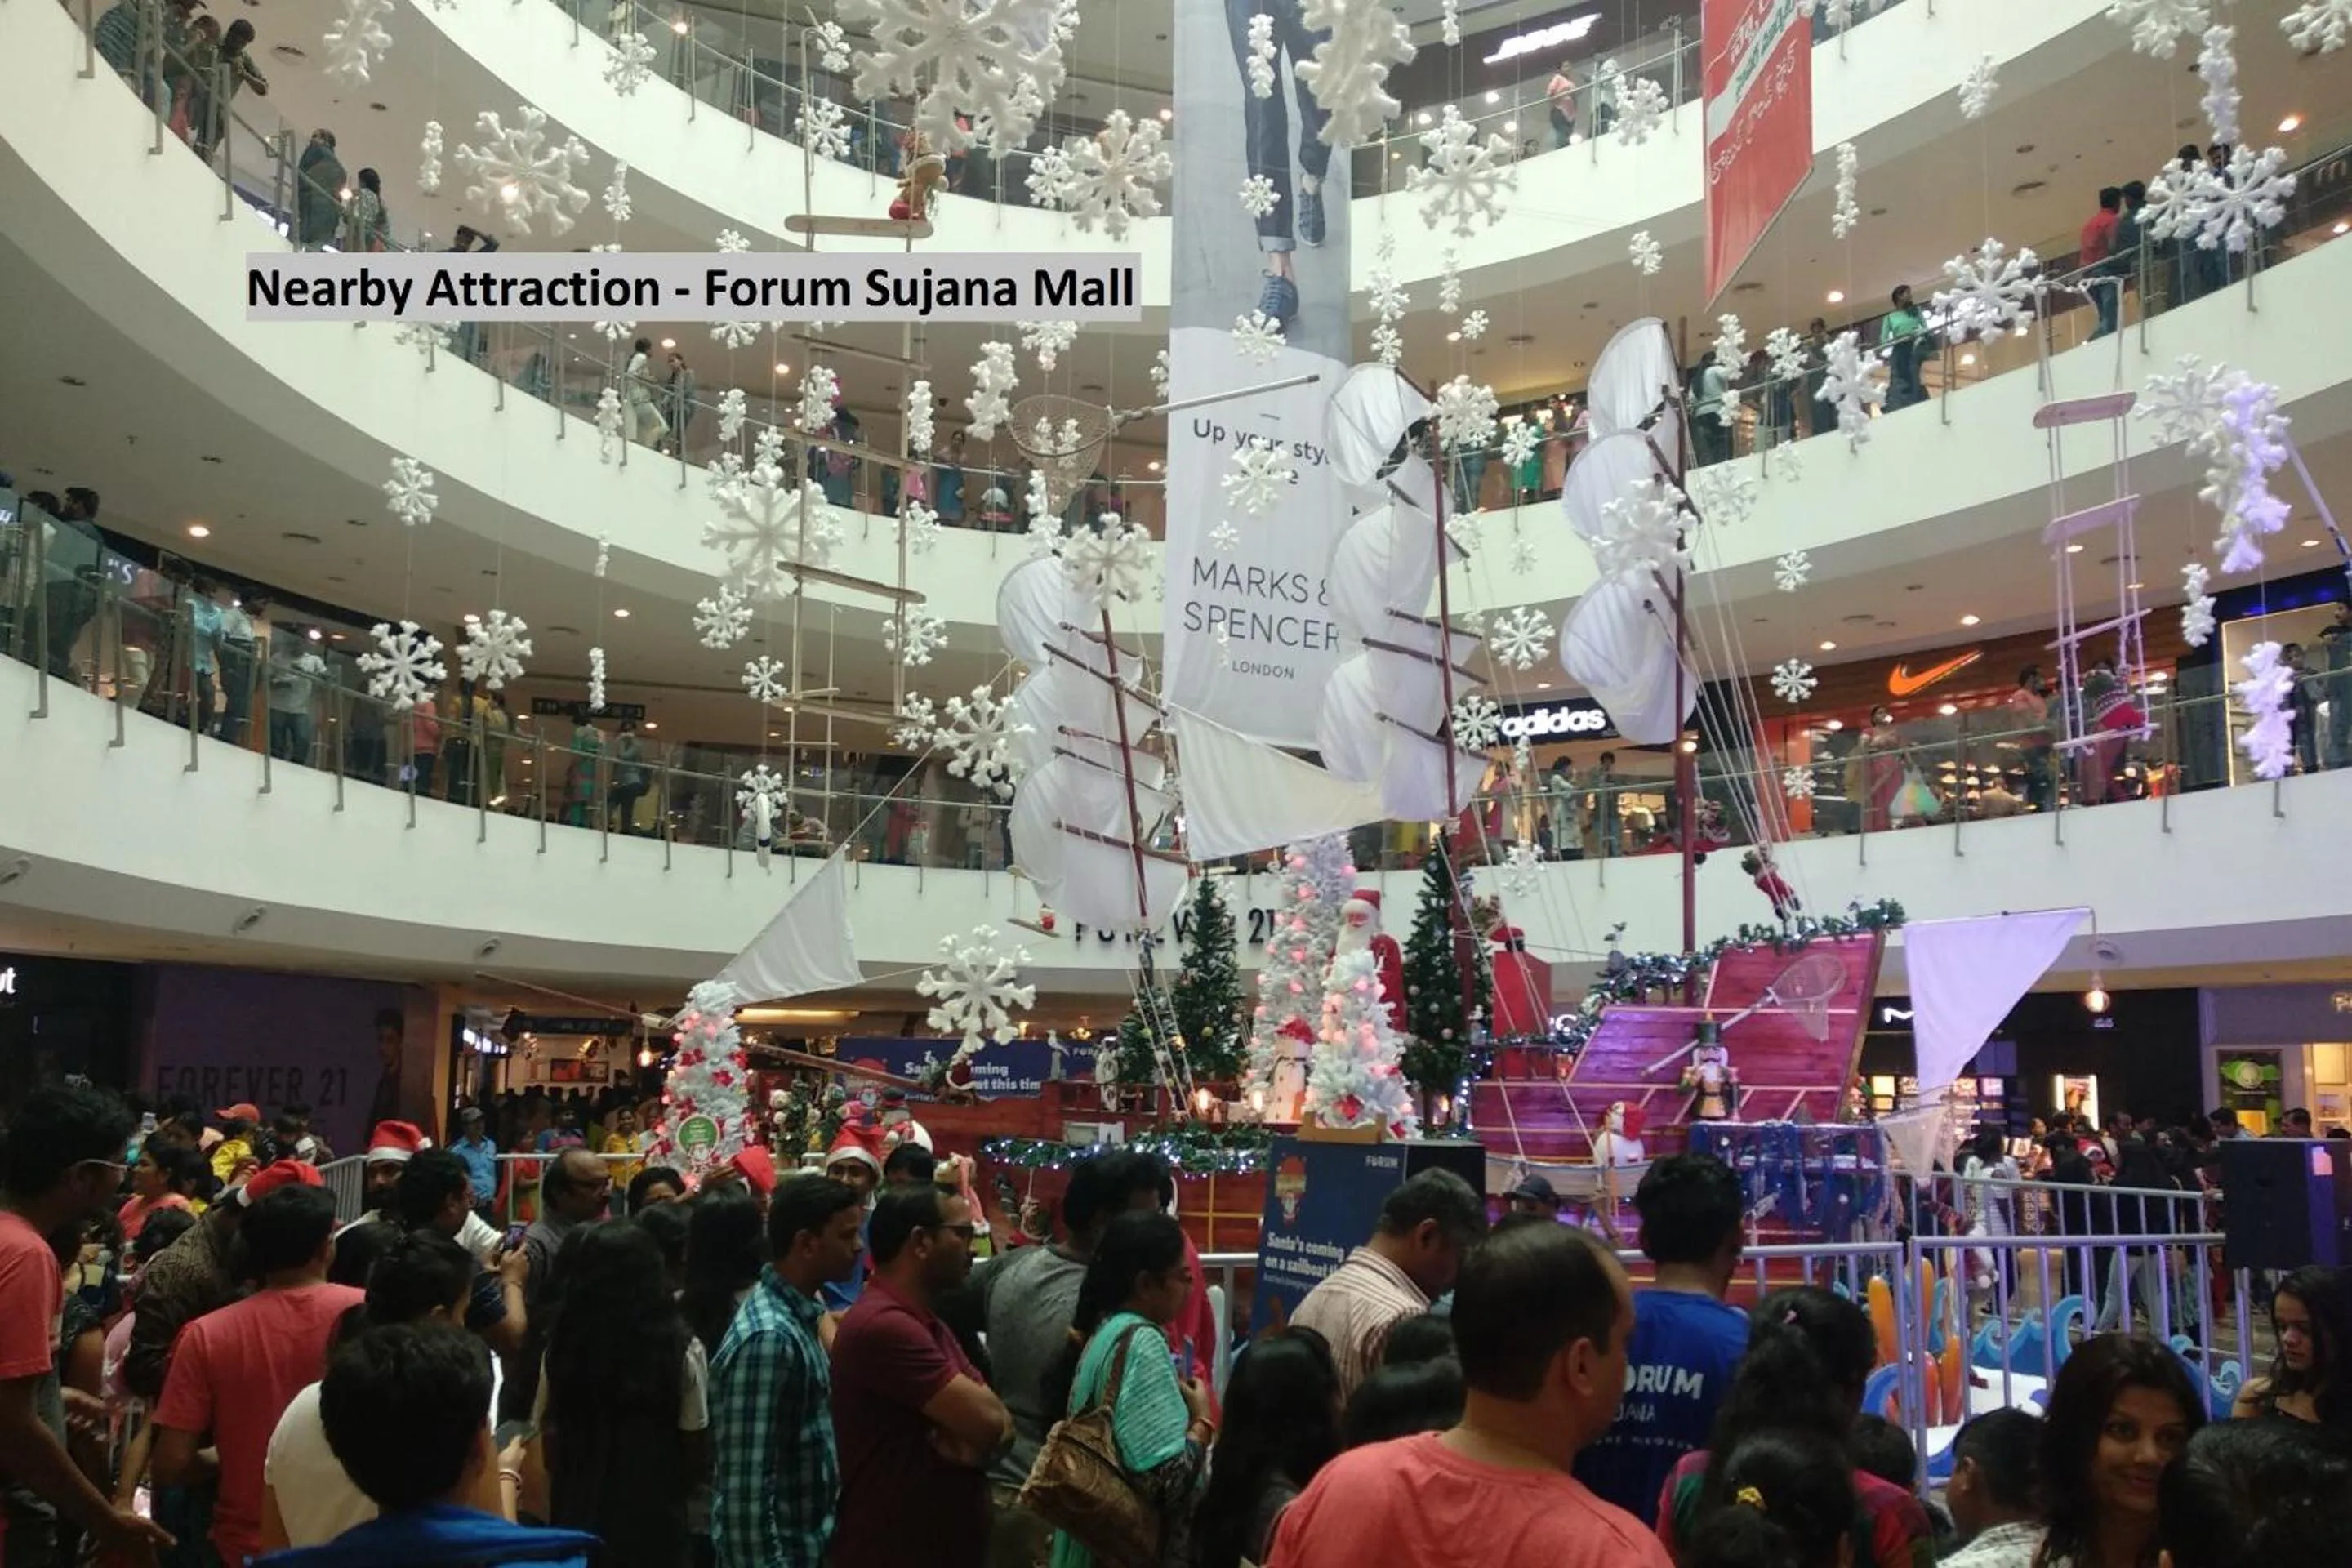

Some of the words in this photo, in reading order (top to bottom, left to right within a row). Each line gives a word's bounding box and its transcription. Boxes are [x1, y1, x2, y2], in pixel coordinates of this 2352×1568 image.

[1193, 418, 1225, 444] Up
[1293, 441, 1330, 466] sty
[1193, 556, 1308, 604] MARKS
[1184, 600, 1340, 653] SPENCER
[1232, 660, 1295, 679] LONDON
[1501, 706, 1606, 737] adidas
[1247, 907, 1276, 944] 21
[157, 1065, 304, 1105] FOREVER
[319, 1067, 348, 1107] 21
[991, 1077, 1018, 1090] this
[1019, 1077, 1041, 1090] tim
[1267, 1231, 1304, 1252] Santa's
[1305, 1241, 1345, 1263] coming
[1264, 1256, 1278, 1268] on
[1279, 1258, 1286, 1270] a
[1286, 1258, 1328, 1278] sailboat
[1624, 1365, 1704, 1399] ORUM
[1612, 1402, 1656, 1423] JANA
